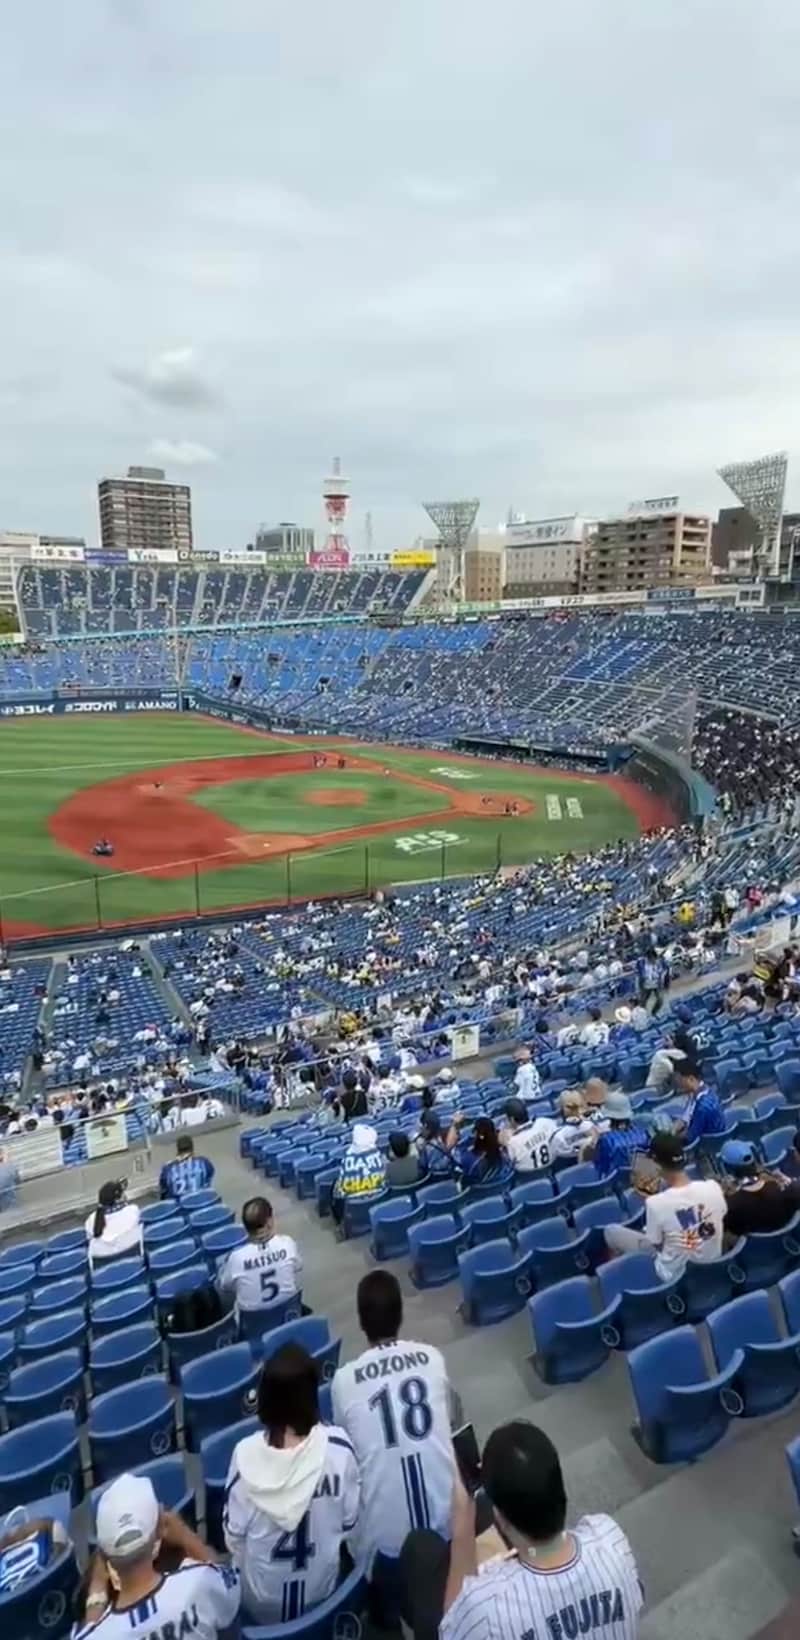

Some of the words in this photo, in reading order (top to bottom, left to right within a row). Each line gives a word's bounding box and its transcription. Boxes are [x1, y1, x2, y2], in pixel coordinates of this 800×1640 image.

[137, 701, 177, 710] AMANO
[530, 1144, 550, 1169] 18
[243, 1249, 288, 1271] MATSUO
[260, 1270, 279, 1302] 5
[354, 1351, 430, 1385] KOZONO
[367, 1375, 433, 1449] 18
[271, 1510, 316, 1572] 4
[546, 1587, 626, 1640] FUJITA
